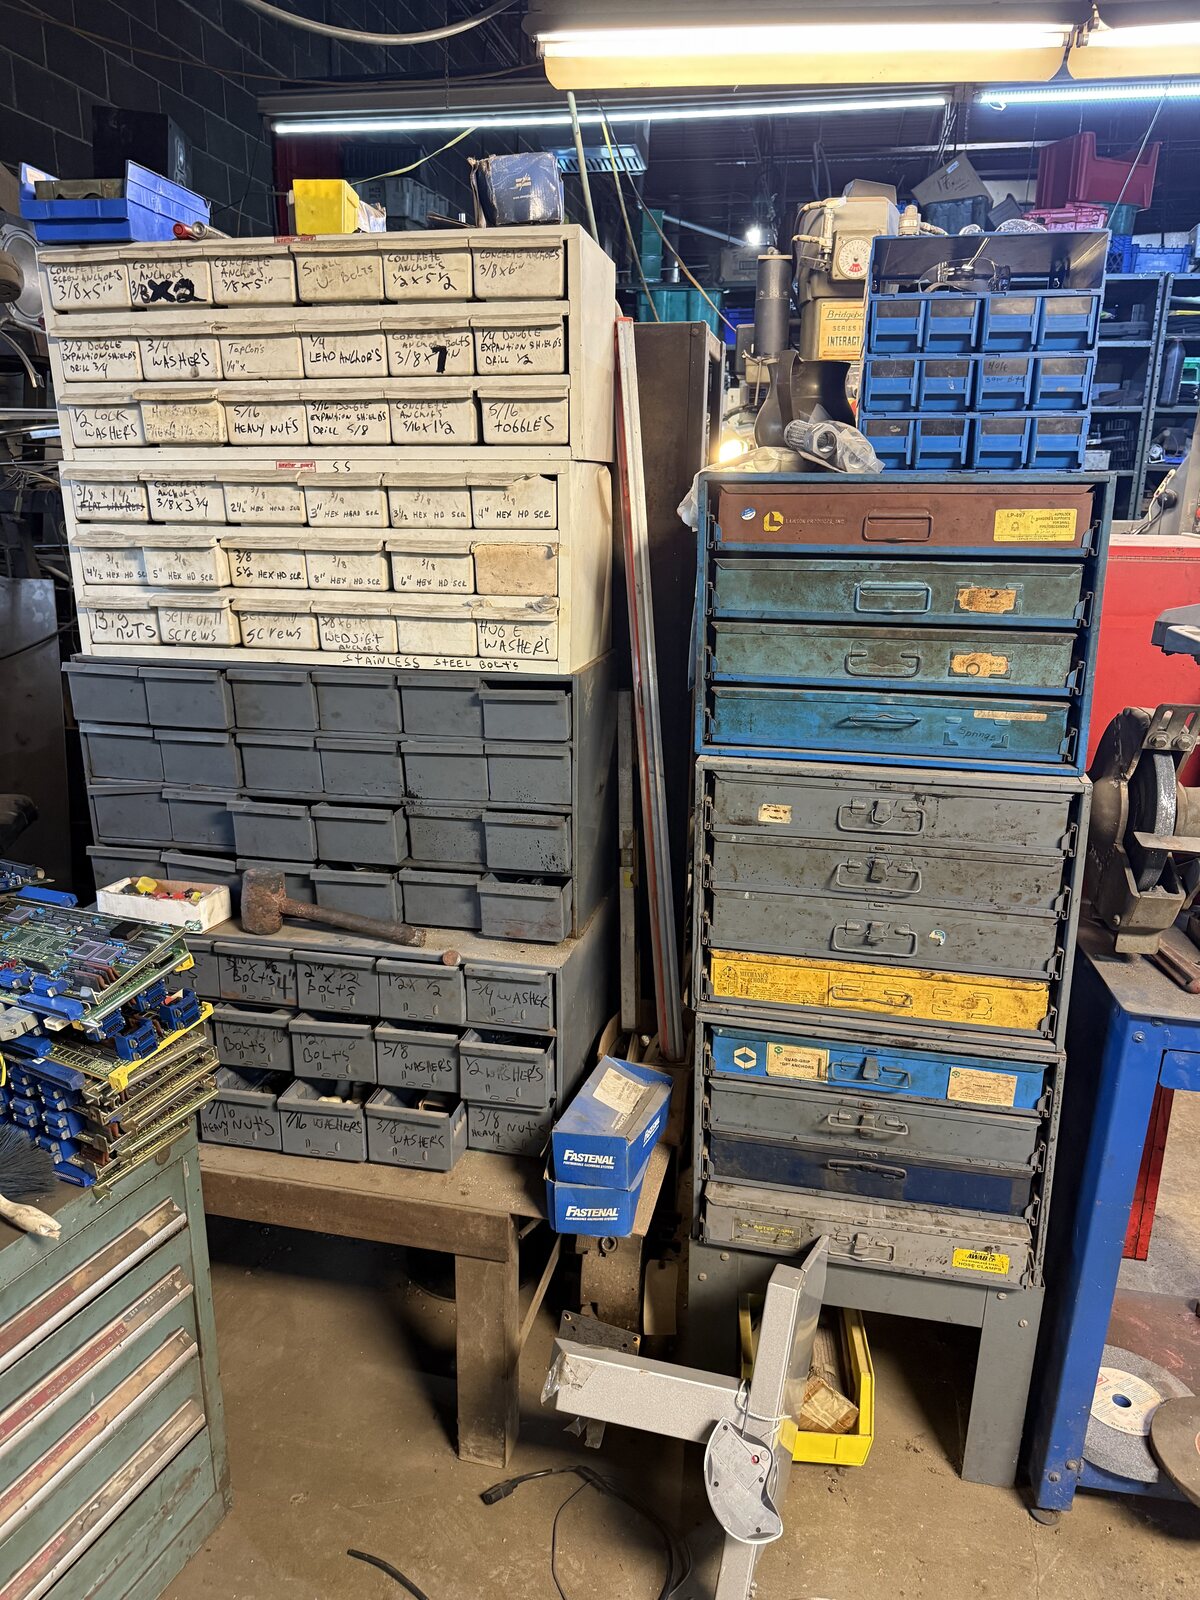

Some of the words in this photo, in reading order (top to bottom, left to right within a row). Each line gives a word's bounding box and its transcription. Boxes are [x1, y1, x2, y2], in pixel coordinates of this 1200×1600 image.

[146, 338, 170, 355] 3/4
[310, 351, 336, 364] LEAD
[233, 405, 260, 418] 5/16
[489, 403, 518, 420] 5/16
[496, 510, 512, 519] HEX
[258, 569, 274, 579] HEX
[563, 1149, 615, 1165] FASTENAL
[565, 1205, 619, 1217] FASTENAL
